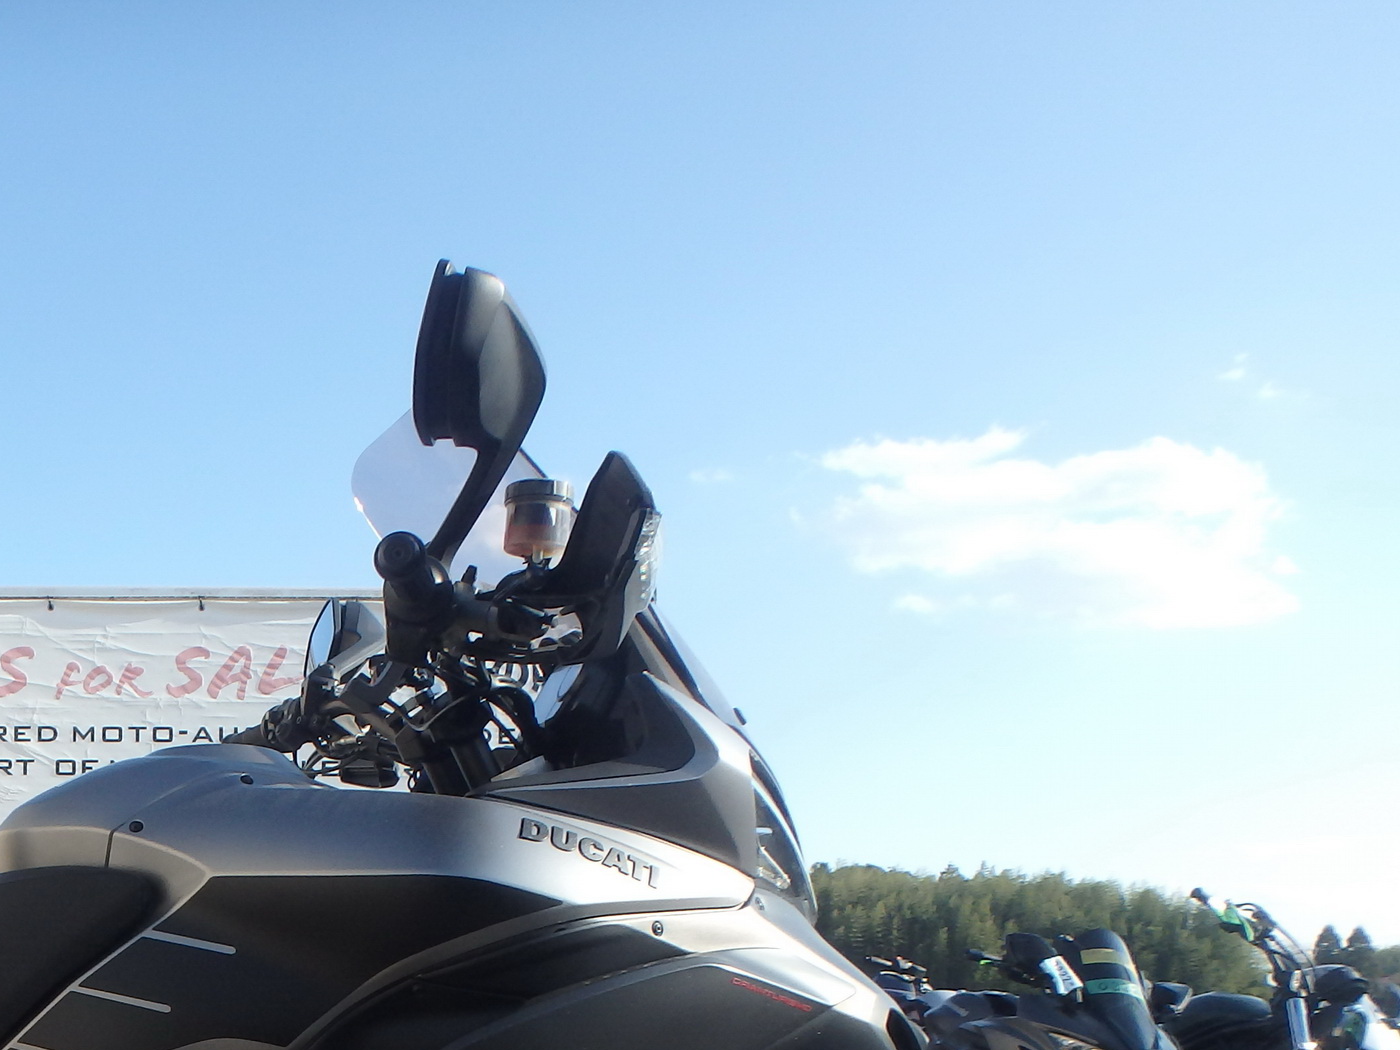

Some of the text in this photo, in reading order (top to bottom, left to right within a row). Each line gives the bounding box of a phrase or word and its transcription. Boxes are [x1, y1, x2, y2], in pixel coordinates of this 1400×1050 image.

[56, 661, 153, 699] FOR
[166, 646, 306, 701] SAL
[72, 726, 238, 743] MOTO-AU
[518, 817, 660, 889] DUCATI
